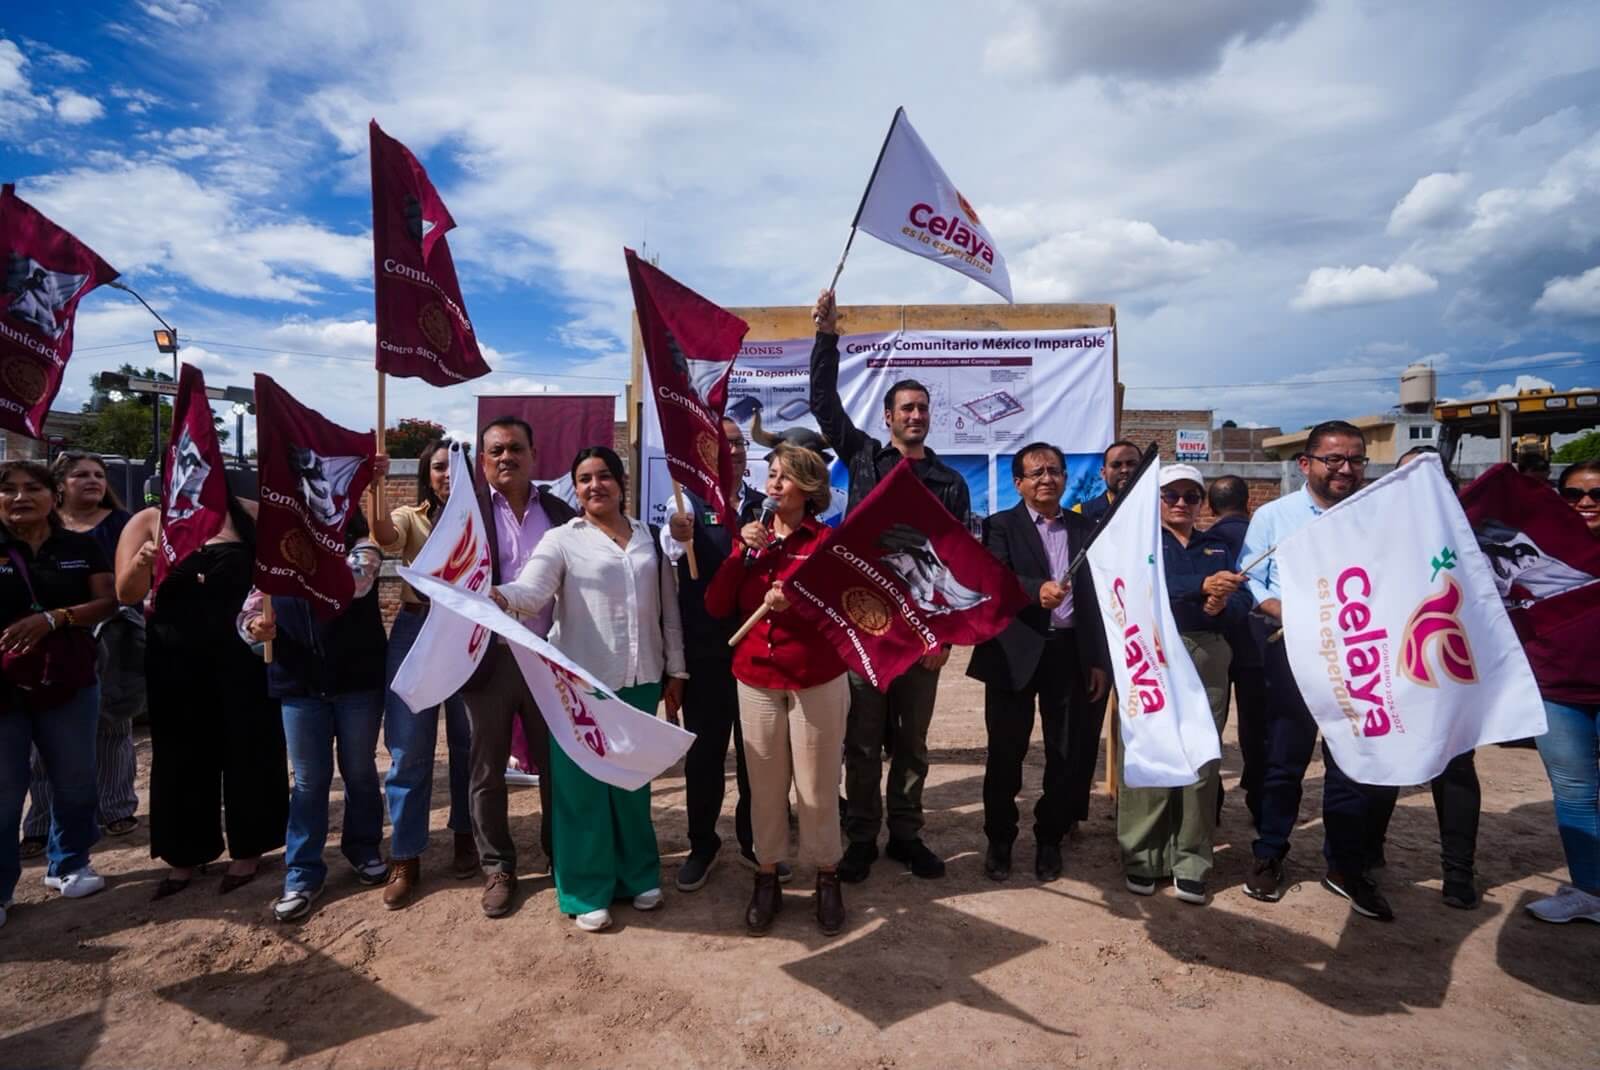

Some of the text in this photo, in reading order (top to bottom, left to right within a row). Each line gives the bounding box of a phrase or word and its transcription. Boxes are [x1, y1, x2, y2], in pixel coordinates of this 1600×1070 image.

[909, 203, 994, 265] Celaya
[901, 226, 992, 274] es la esperanza
[380, 340, 413, 354] Centro
[416, 347, 438, 363] SICT
[741, 346, 784, 355] IONES
[846, 335, 1105, 354] Centro Comunitario México Imparable
[756, 368, 810, 378] Deportiva
[1179, 442, 1206, 450] VENTA
[666, 453, 696, 473] Centro
[270, 567, 297, 577] SICT
[1317, 577, 1331, 600] es
[1320, 604, 1335, 622] la
[793, 580, 825, 608] Centro
[825, 607, 848, 629] SICT
[847, 627, 878, 688] Guanajuato
[1336, 567, 1392, 738] Celaya
[1381, 643, 1392, 688] GOBIERNO
